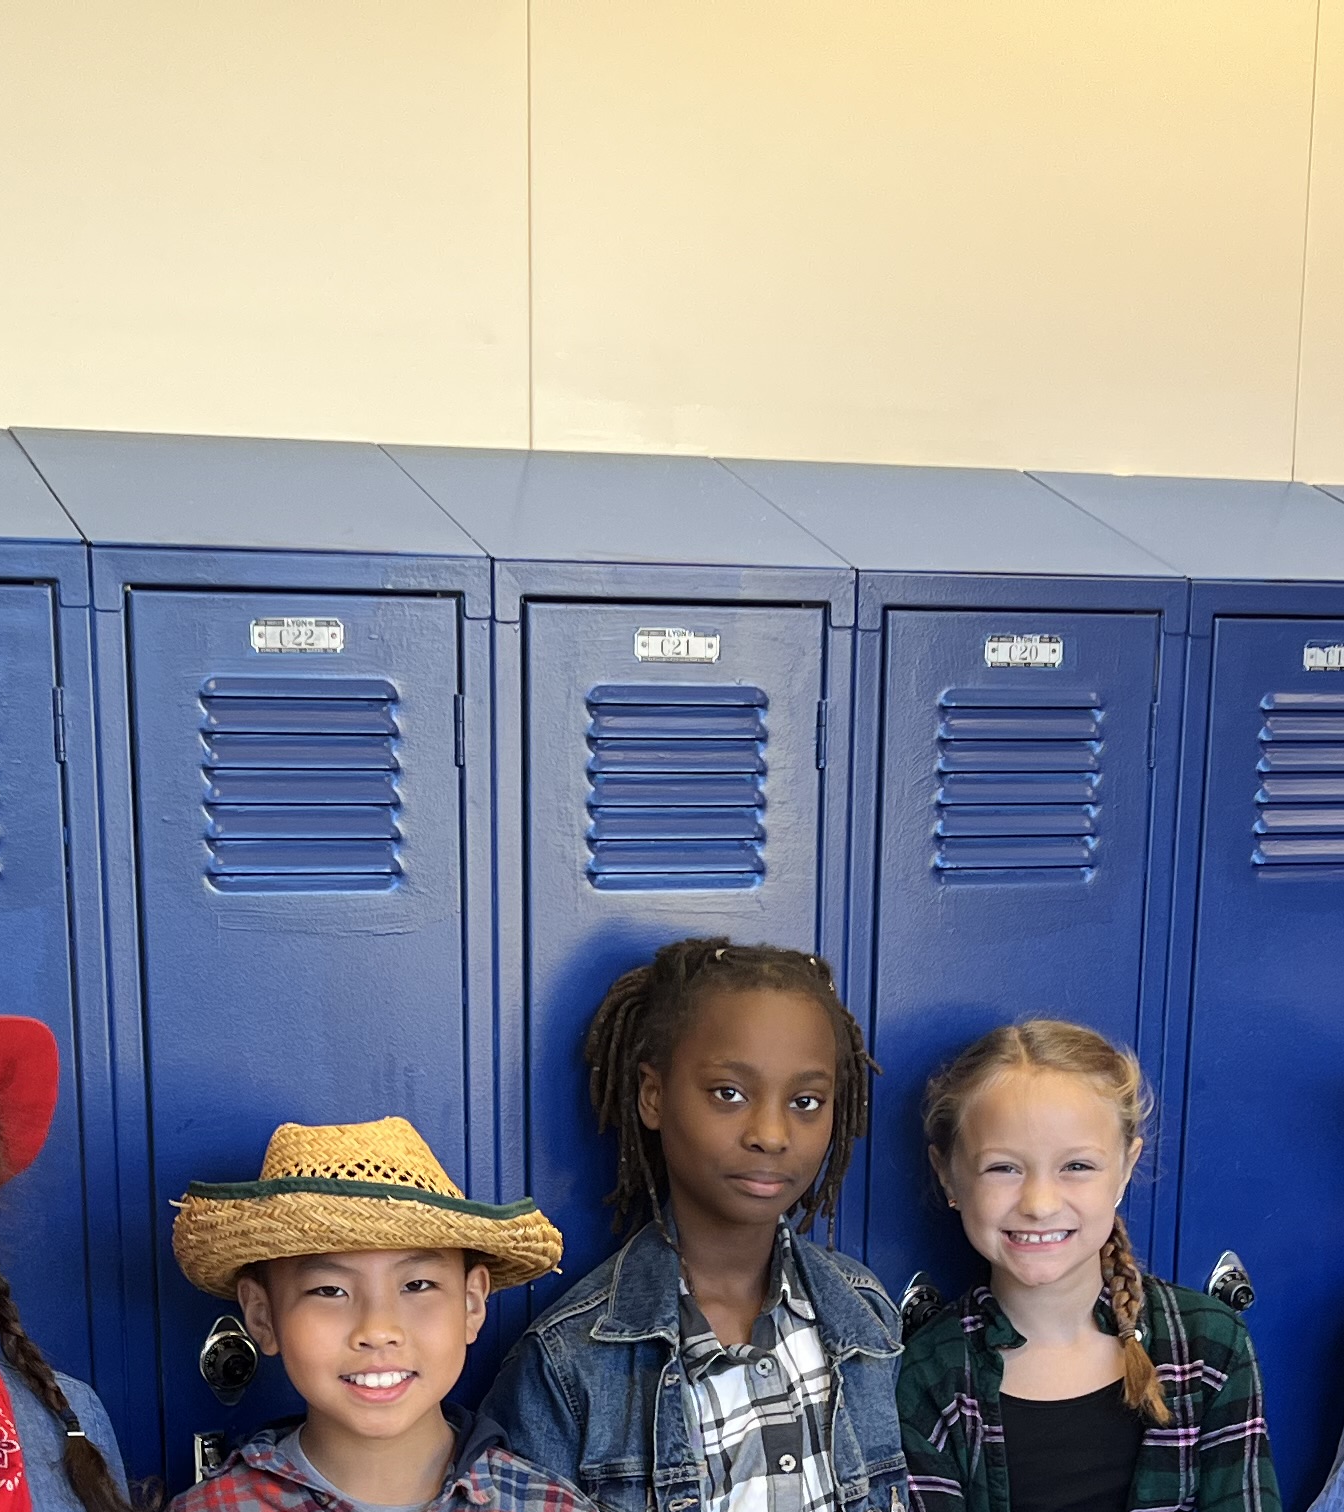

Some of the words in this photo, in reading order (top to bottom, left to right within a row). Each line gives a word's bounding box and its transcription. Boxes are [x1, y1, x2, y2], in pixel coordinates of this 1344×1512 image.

[286, 619, 308, 628] LYON
[279, 629, 316, 647] C22
[660, 638, 691, 656] C21
[1008, 644, 1039, 661] C20
